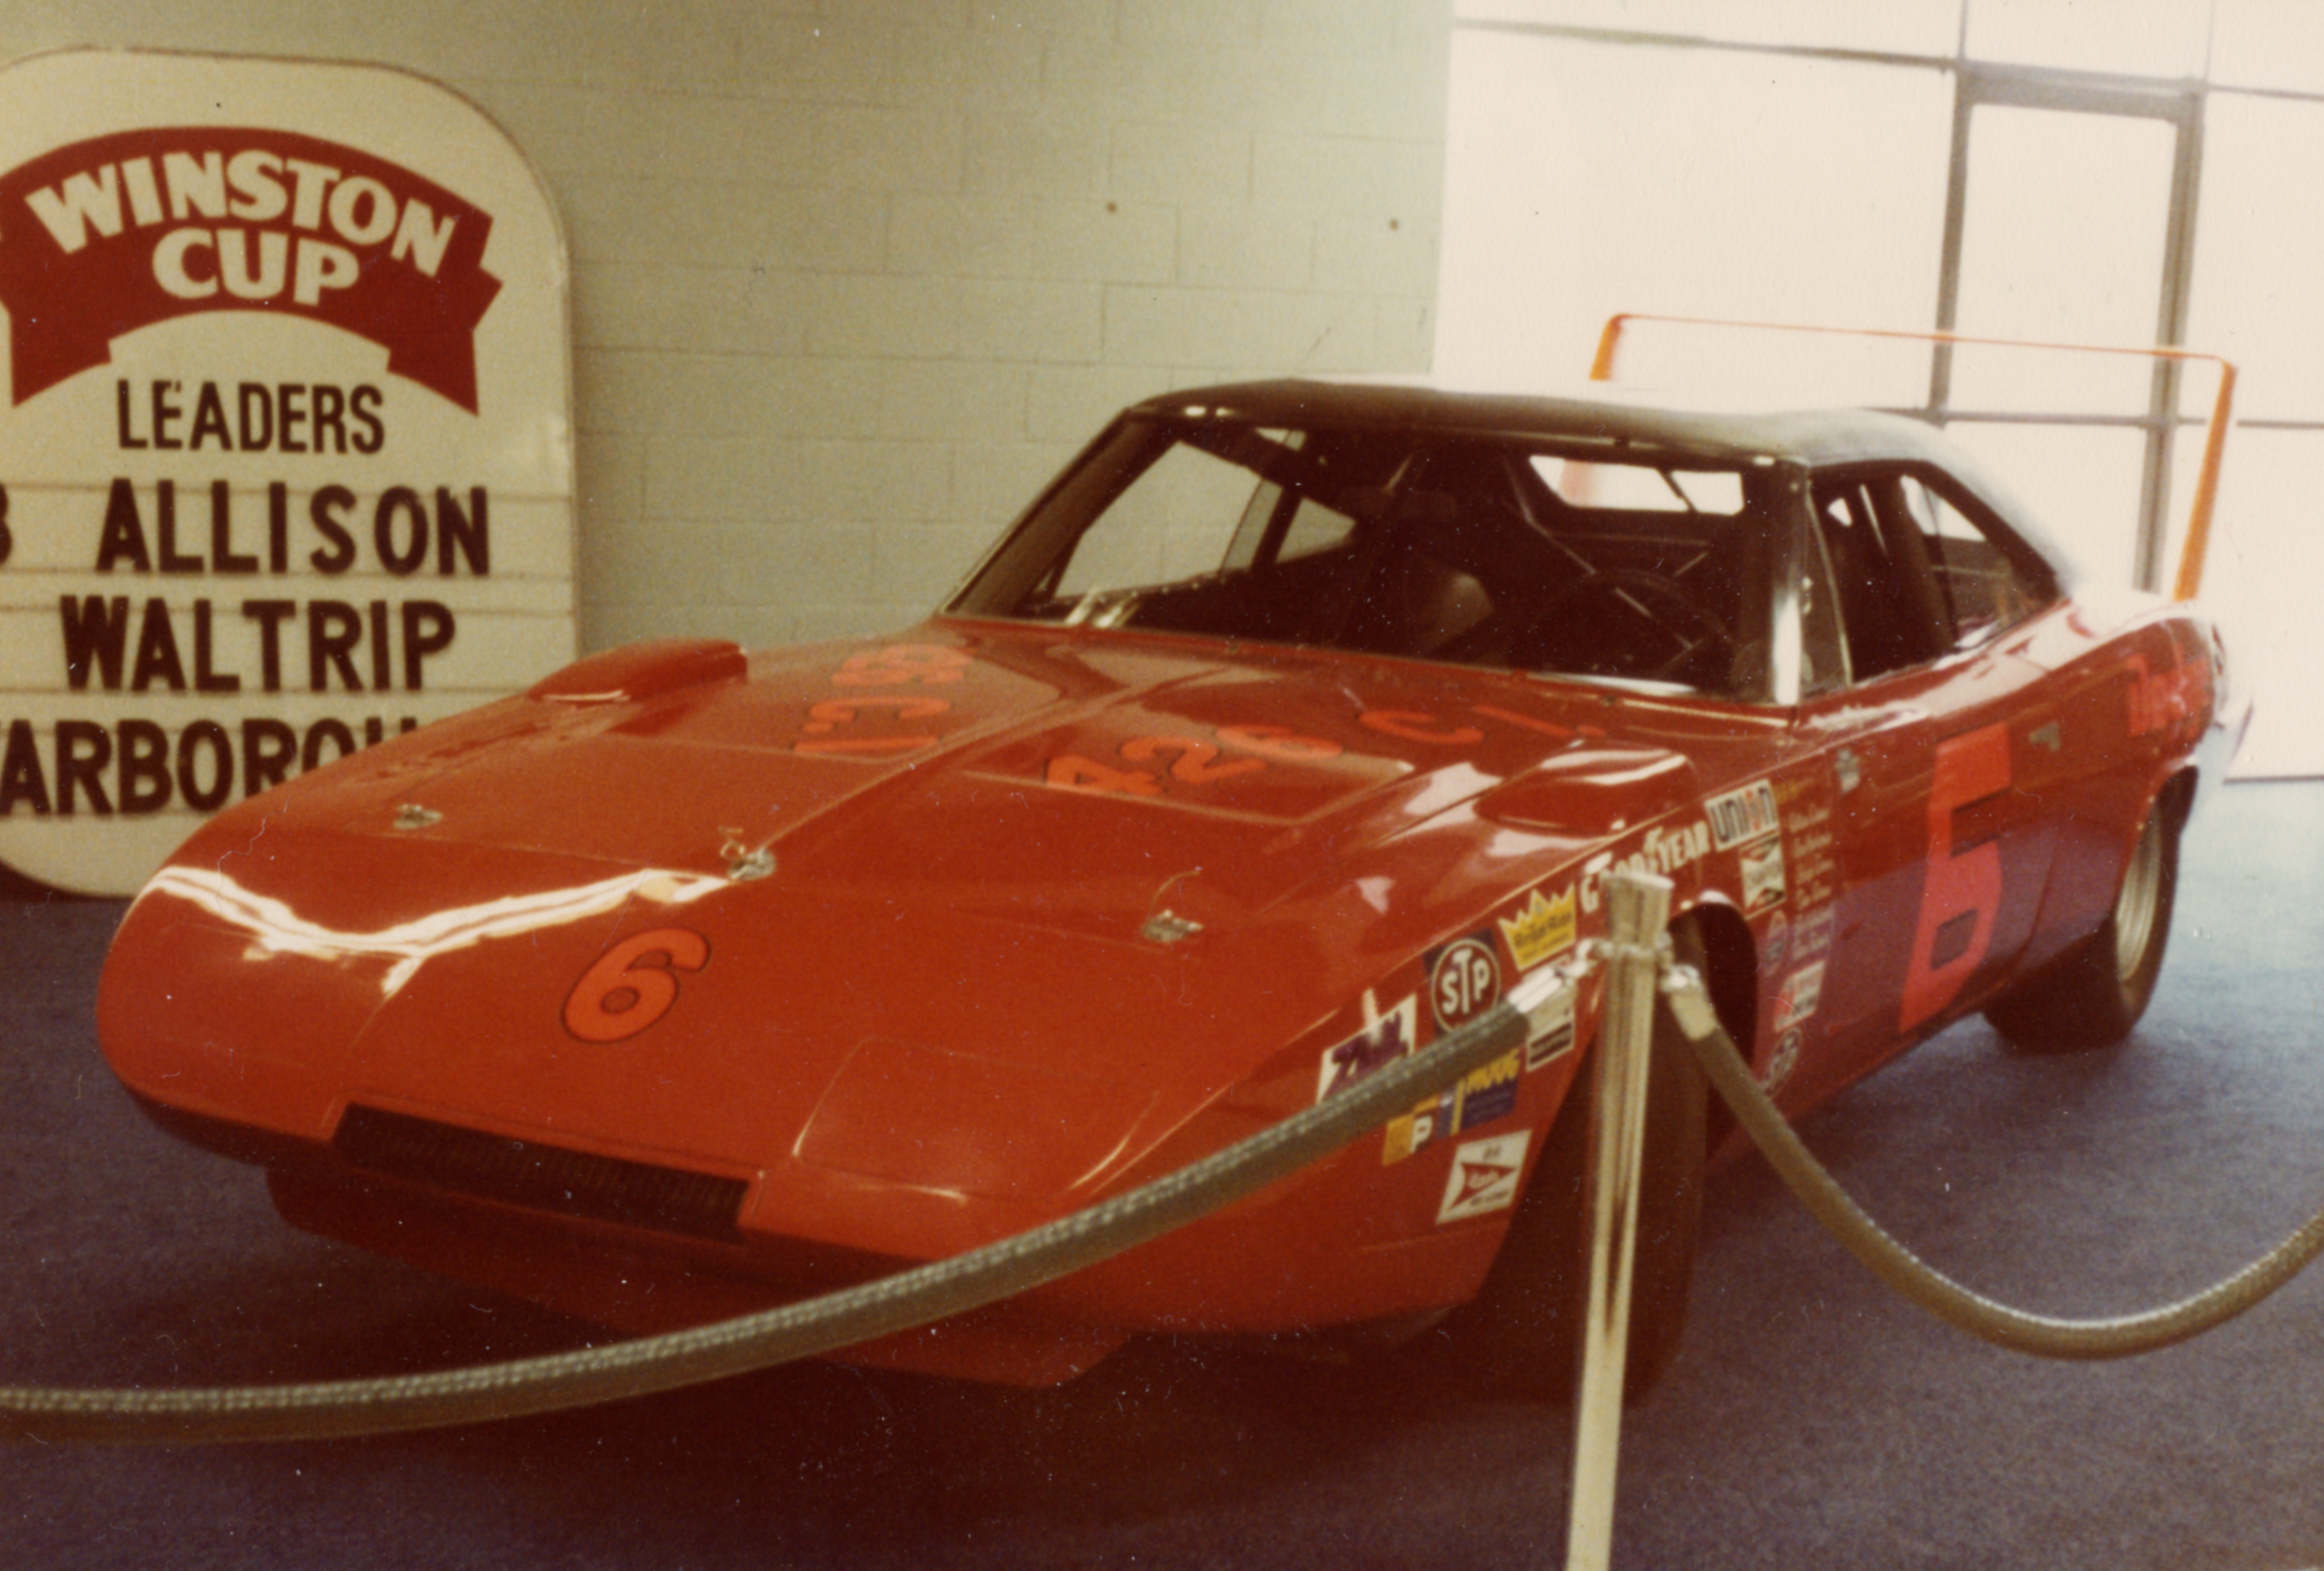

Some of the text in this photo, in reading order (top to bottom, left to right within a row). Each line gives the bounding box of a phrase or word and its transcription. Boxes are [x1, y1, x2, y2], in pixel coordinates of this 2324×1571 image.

[24, 148, 456, 278] WINSTON
[152, 228, 360, 306] CUP
[116, 379, 385, 454] LEADERS
[95, 477, 490, 577] ALLISON
[60, 595, 456, 693] WALTRIP
[0, 717, 417, 817] ARBORO
[1899, 720, 2012, 1035] 6
[560, 926, 712, 1044] 6
[1440, 949, 1490, 1014] STP
